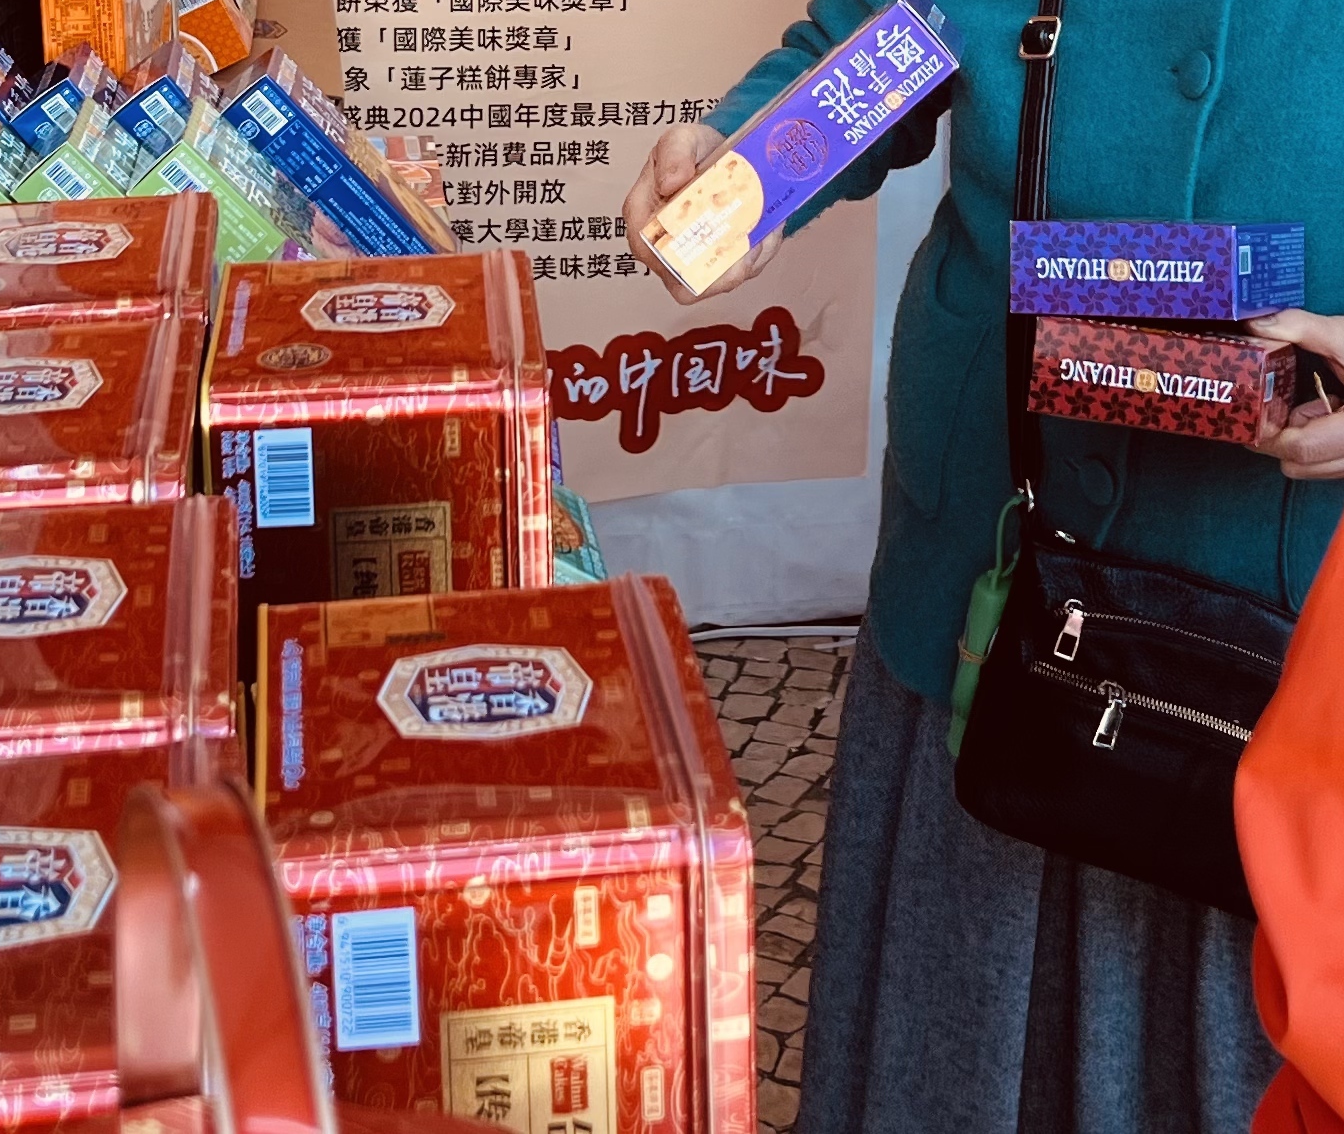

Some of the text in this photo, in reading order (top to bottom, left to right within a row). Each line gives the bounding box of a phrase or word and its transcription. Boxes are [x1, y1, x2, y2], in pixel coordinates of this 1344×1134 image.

[844, 103, 892, 146] HUANG
[1036, 257, 1205, 283] ZHIZUN HUANG
[1060, 358, 1235, 404] ZHIZUN HUANG
